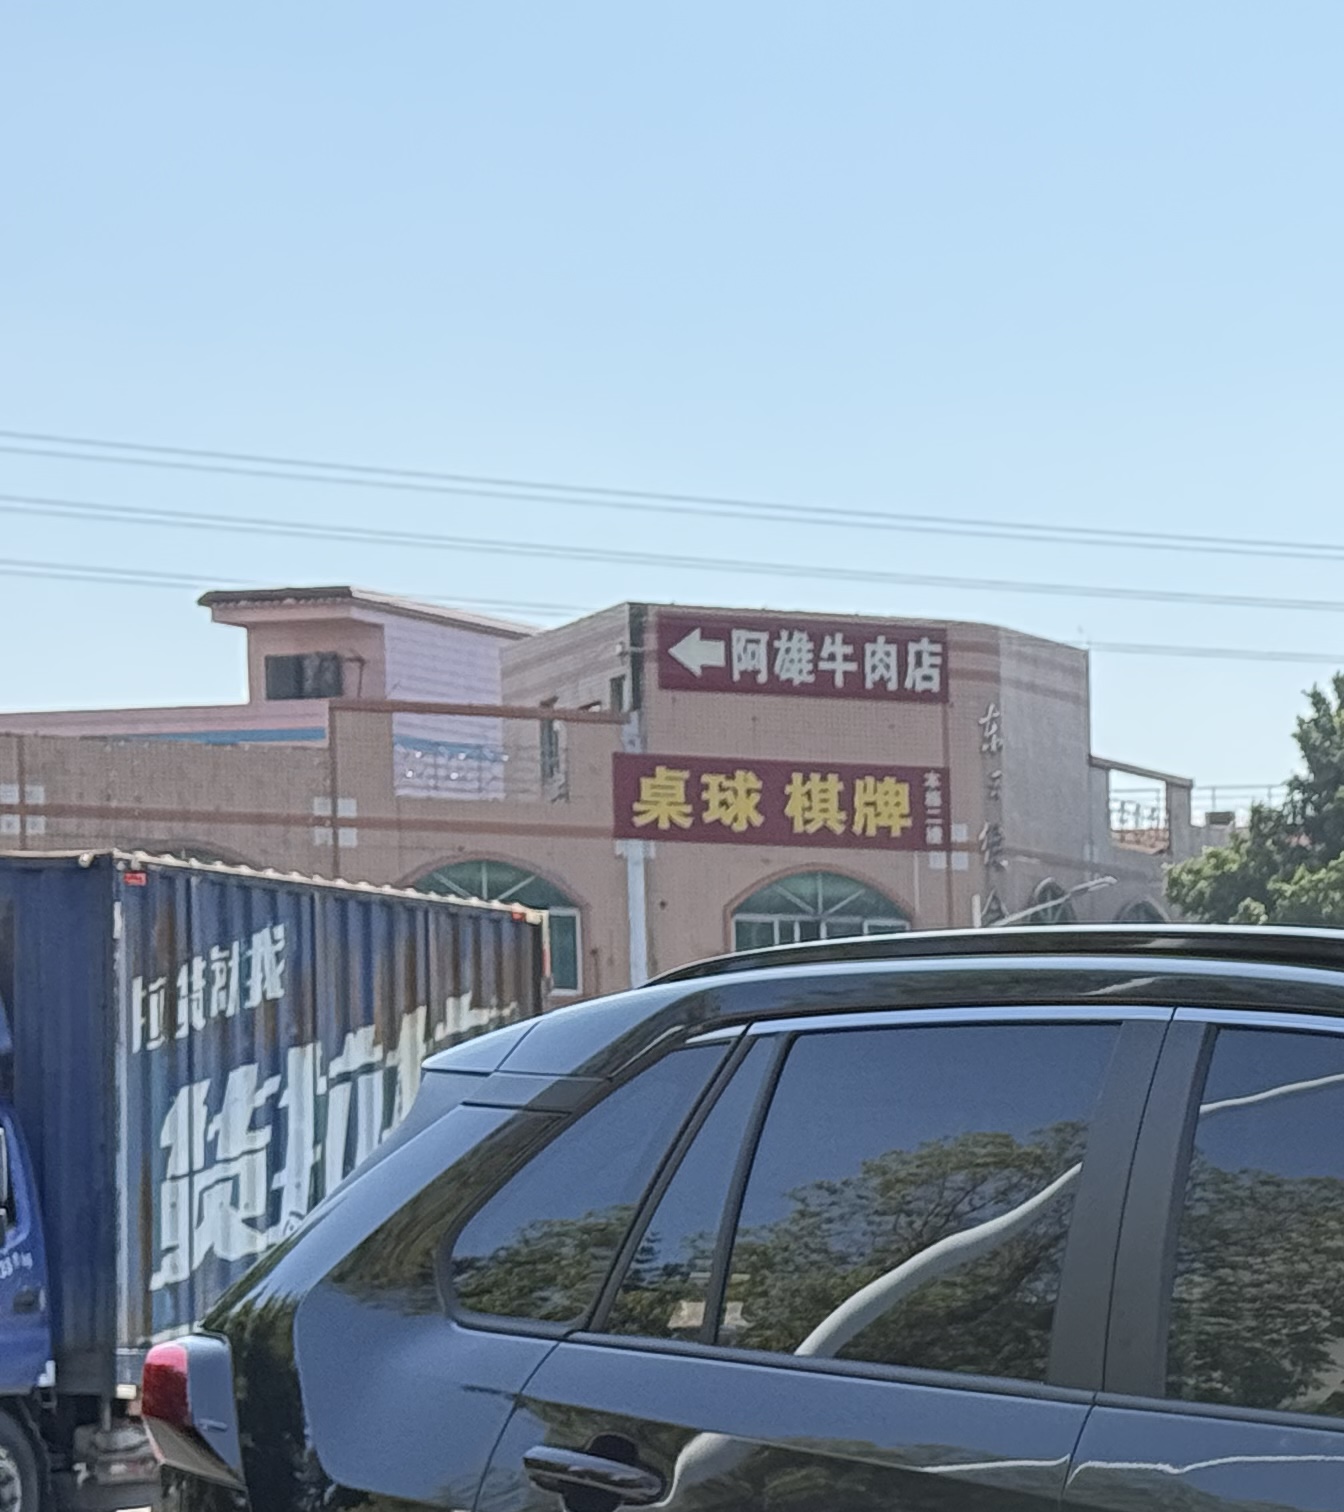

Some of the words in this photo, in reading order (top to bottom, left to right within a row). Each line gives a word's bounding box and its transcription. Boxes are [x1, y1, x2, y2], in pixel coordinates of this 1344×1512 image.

[731, 627, 943, 693] 阿雄牛肉店
[633, 766, 764, 832] 桌球
[784, 772, 911, 837] 棋牌
